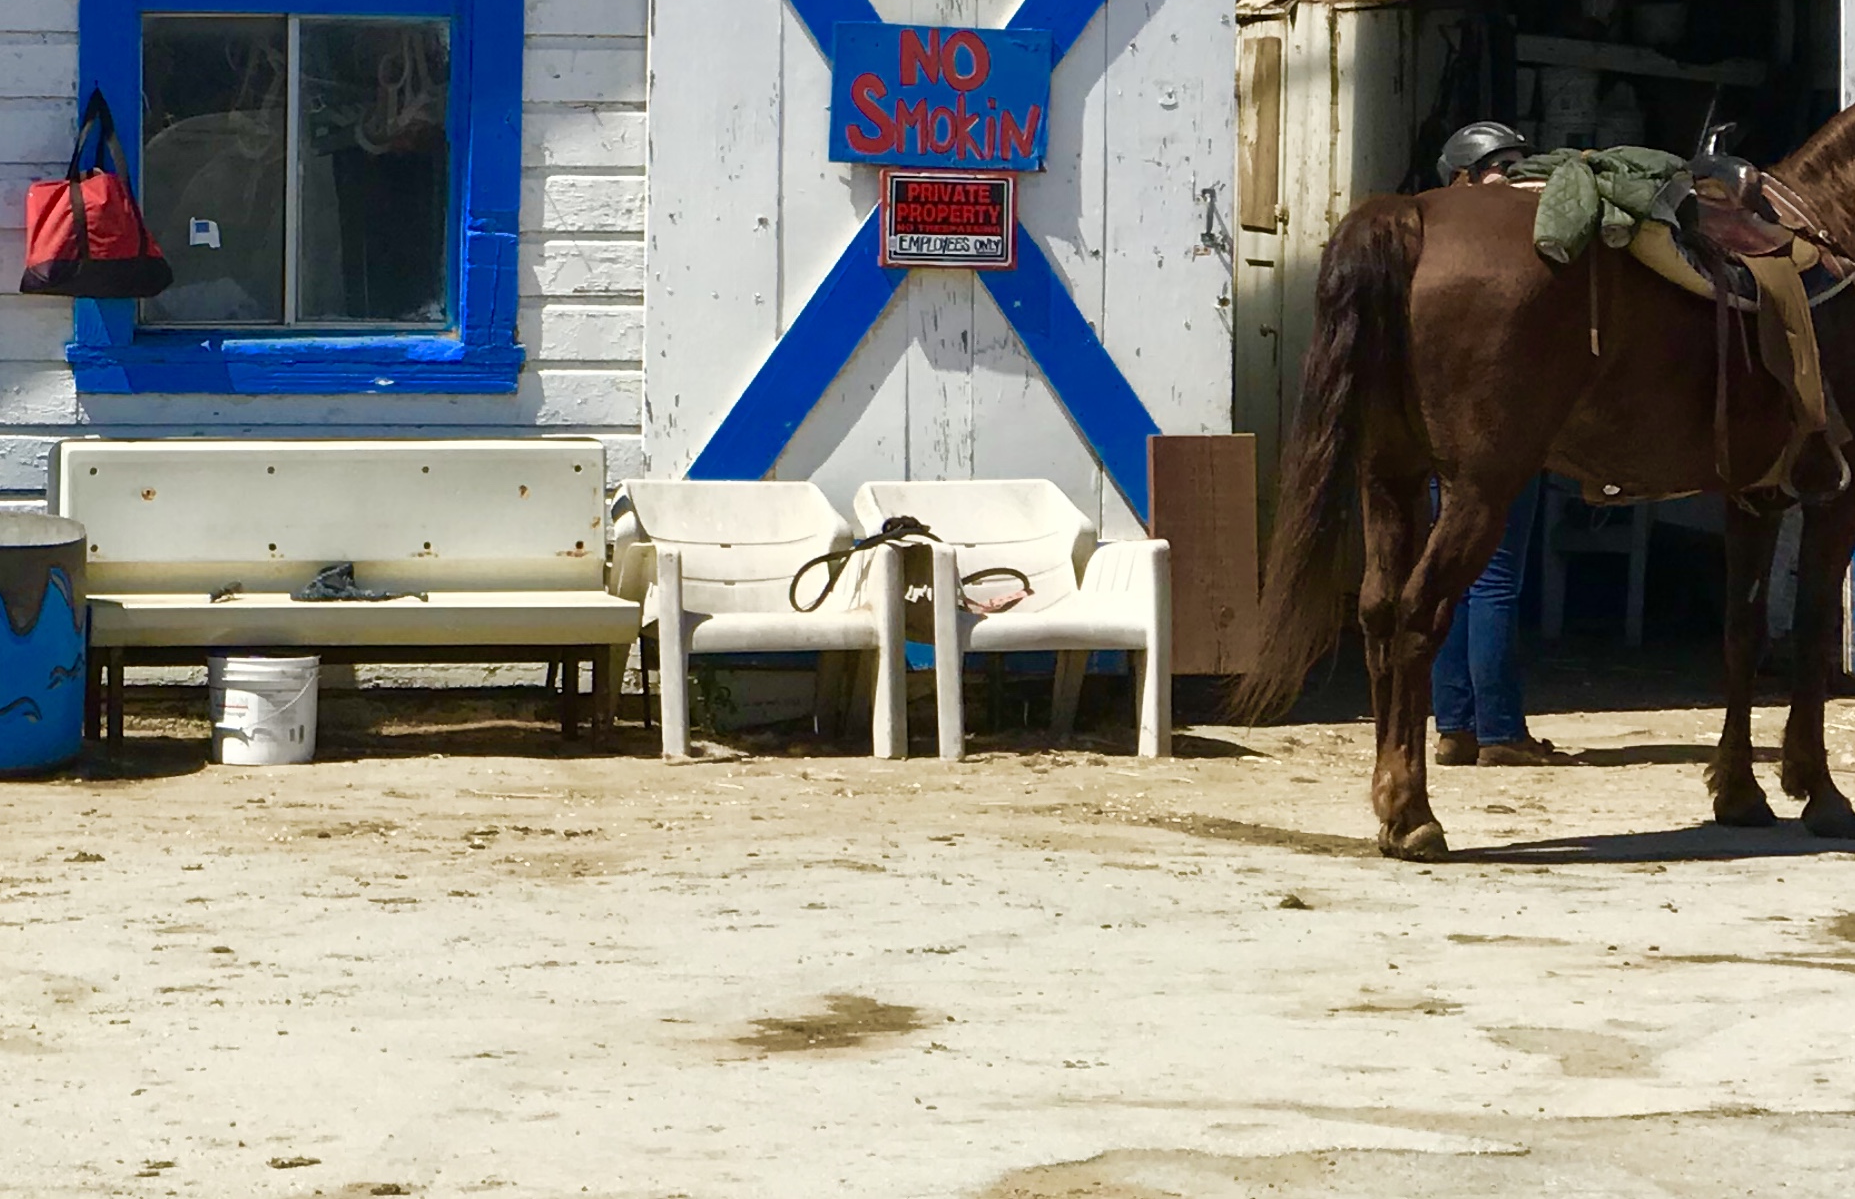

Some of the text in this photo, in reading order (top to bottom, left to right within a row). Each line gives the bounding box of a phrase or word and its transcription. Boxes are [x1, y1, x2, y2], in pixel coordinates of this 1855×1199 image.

[899, 28, 991, 92] NO
[907, 183, 992, 203] PRIVATE
[896, 202, 1001, 223] PROPERTY
[896, 224, 914, 232] NO
[898, 235, 1002, 254] EMPLOYEES ONLY
